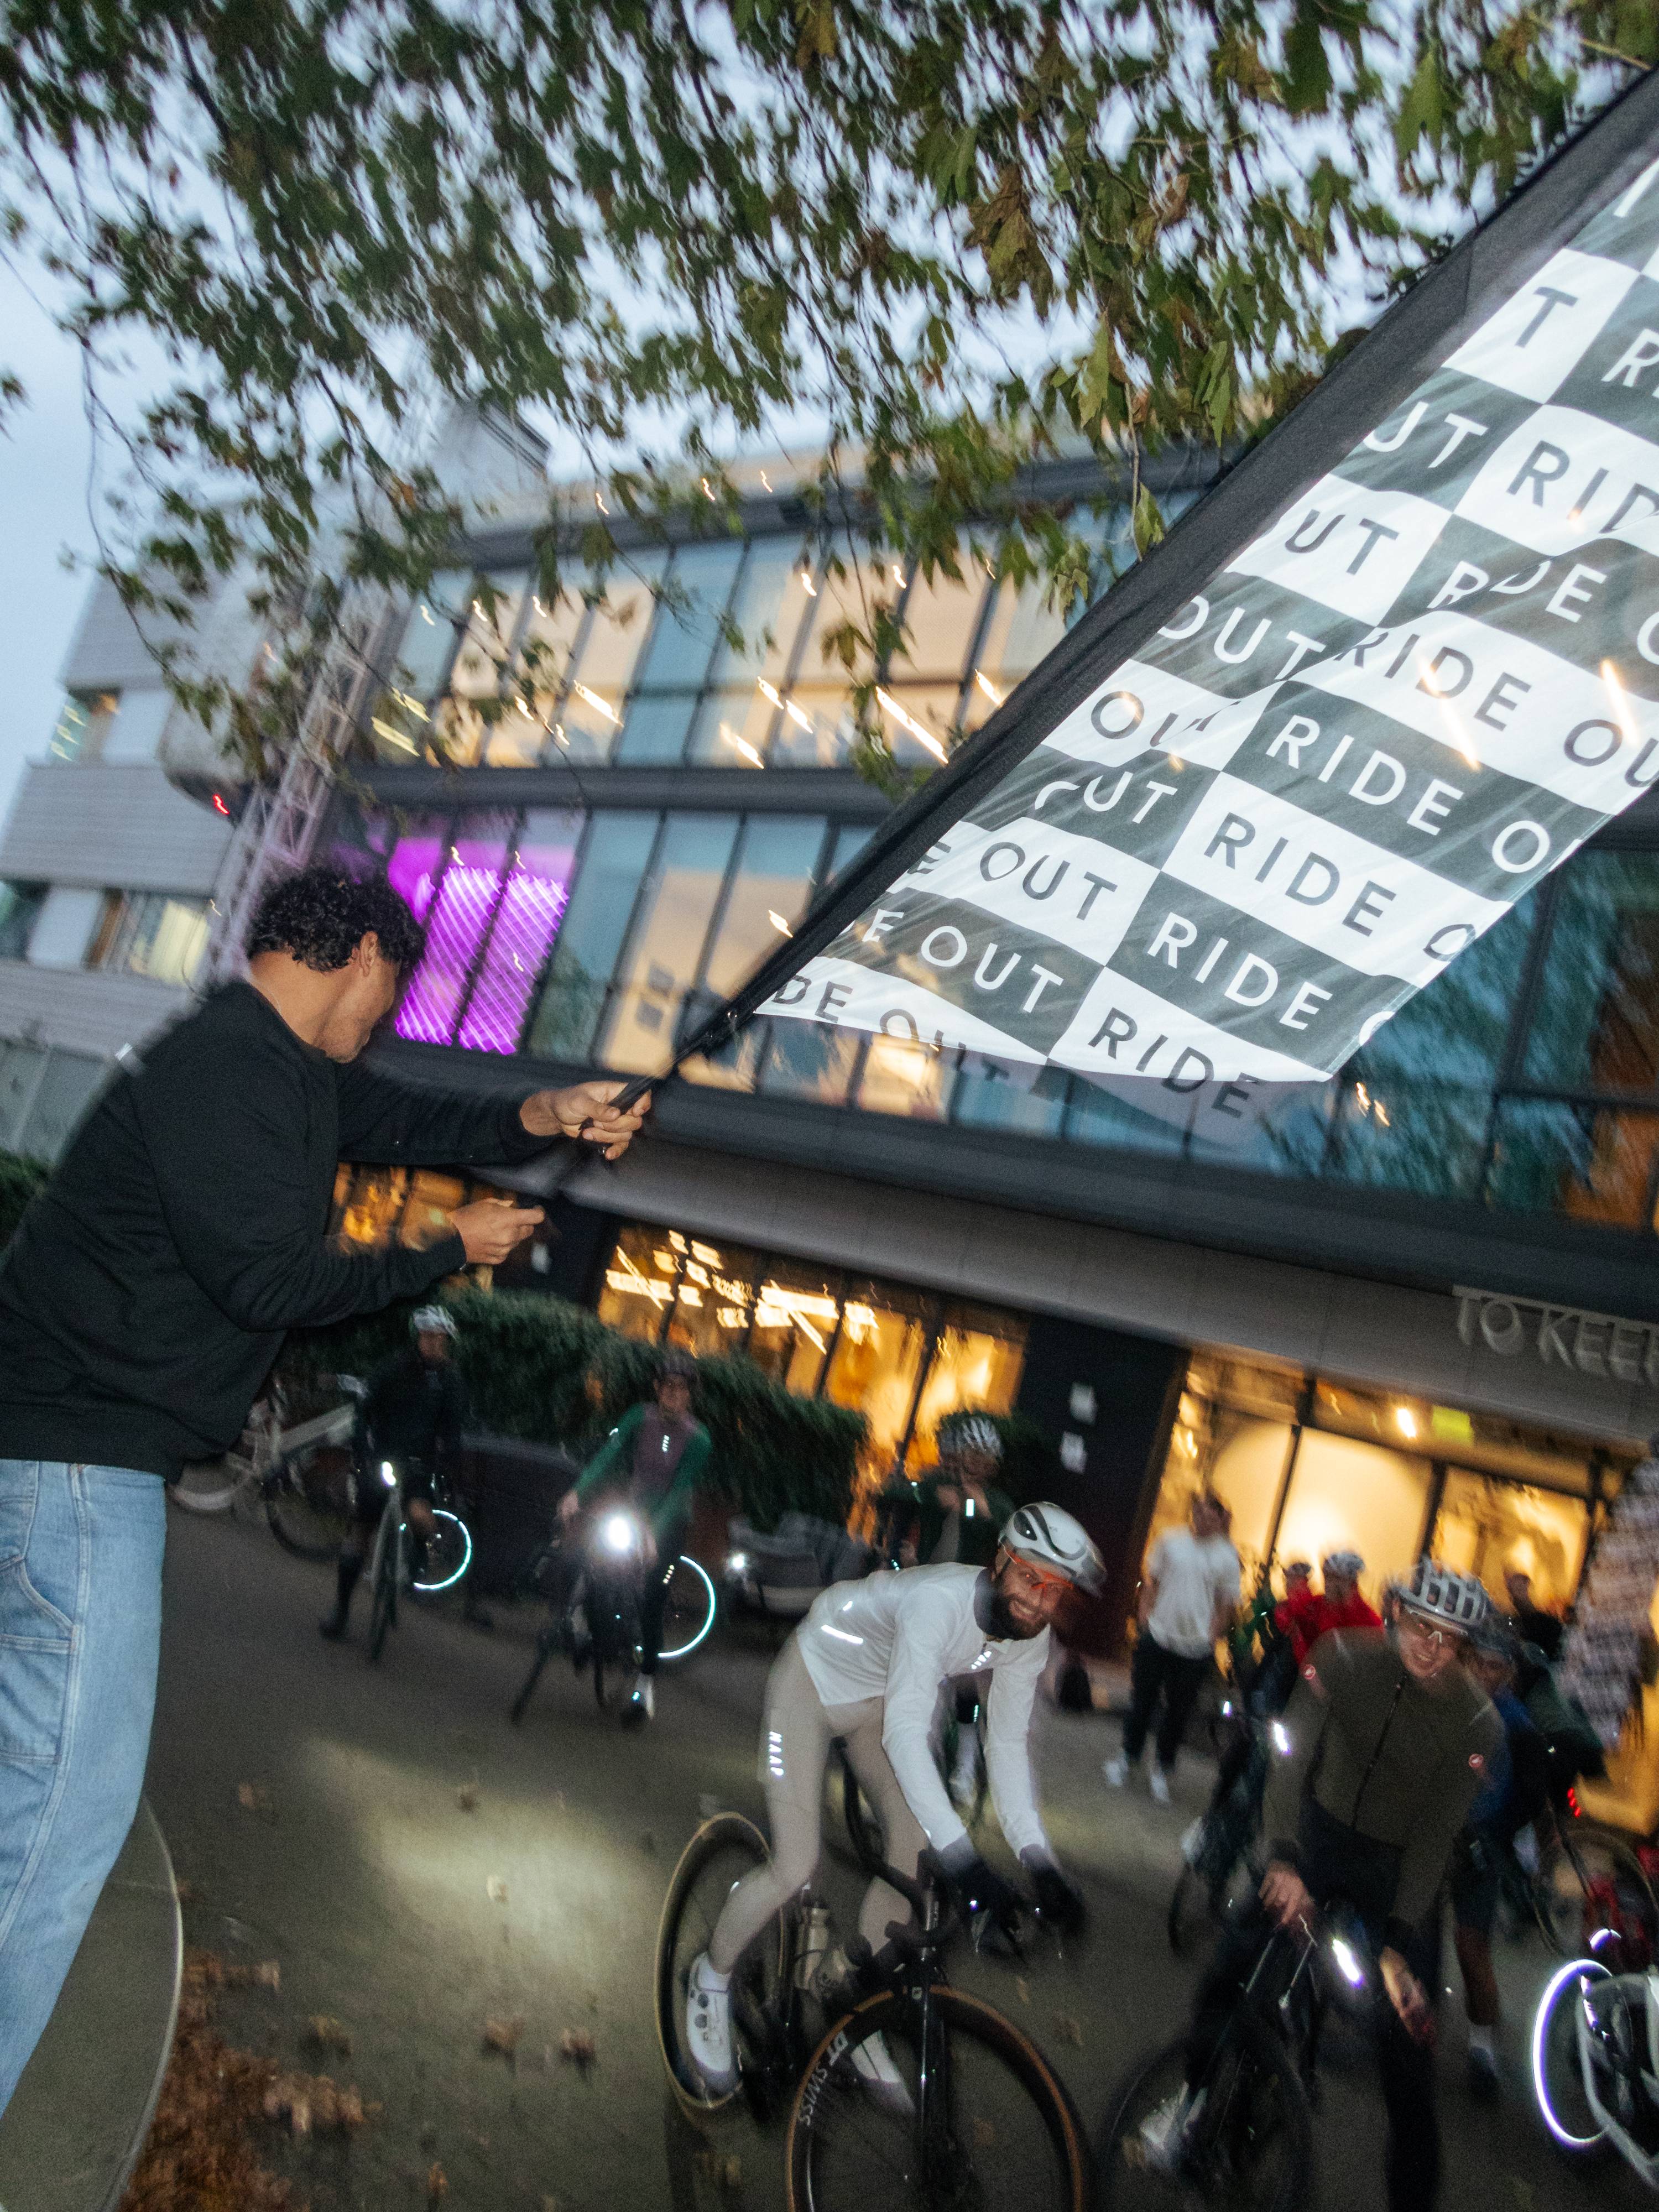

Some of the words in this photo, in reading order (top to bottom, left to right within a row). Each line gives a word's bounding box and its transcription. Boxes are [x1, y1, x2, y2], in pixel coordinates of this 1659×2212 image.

[1203, 812, 1397, 937] RIDE
[1265, 714, 1464, 836] RIDE
[1492, 820, 1550, 874] O
[921, 925, 1063, 1013] OUT
[1087, 1007, 1260, 1119] RIDE
[979, 842, 1118, 920] OUT
[1147, 911, 1333, 1031] RIDE
